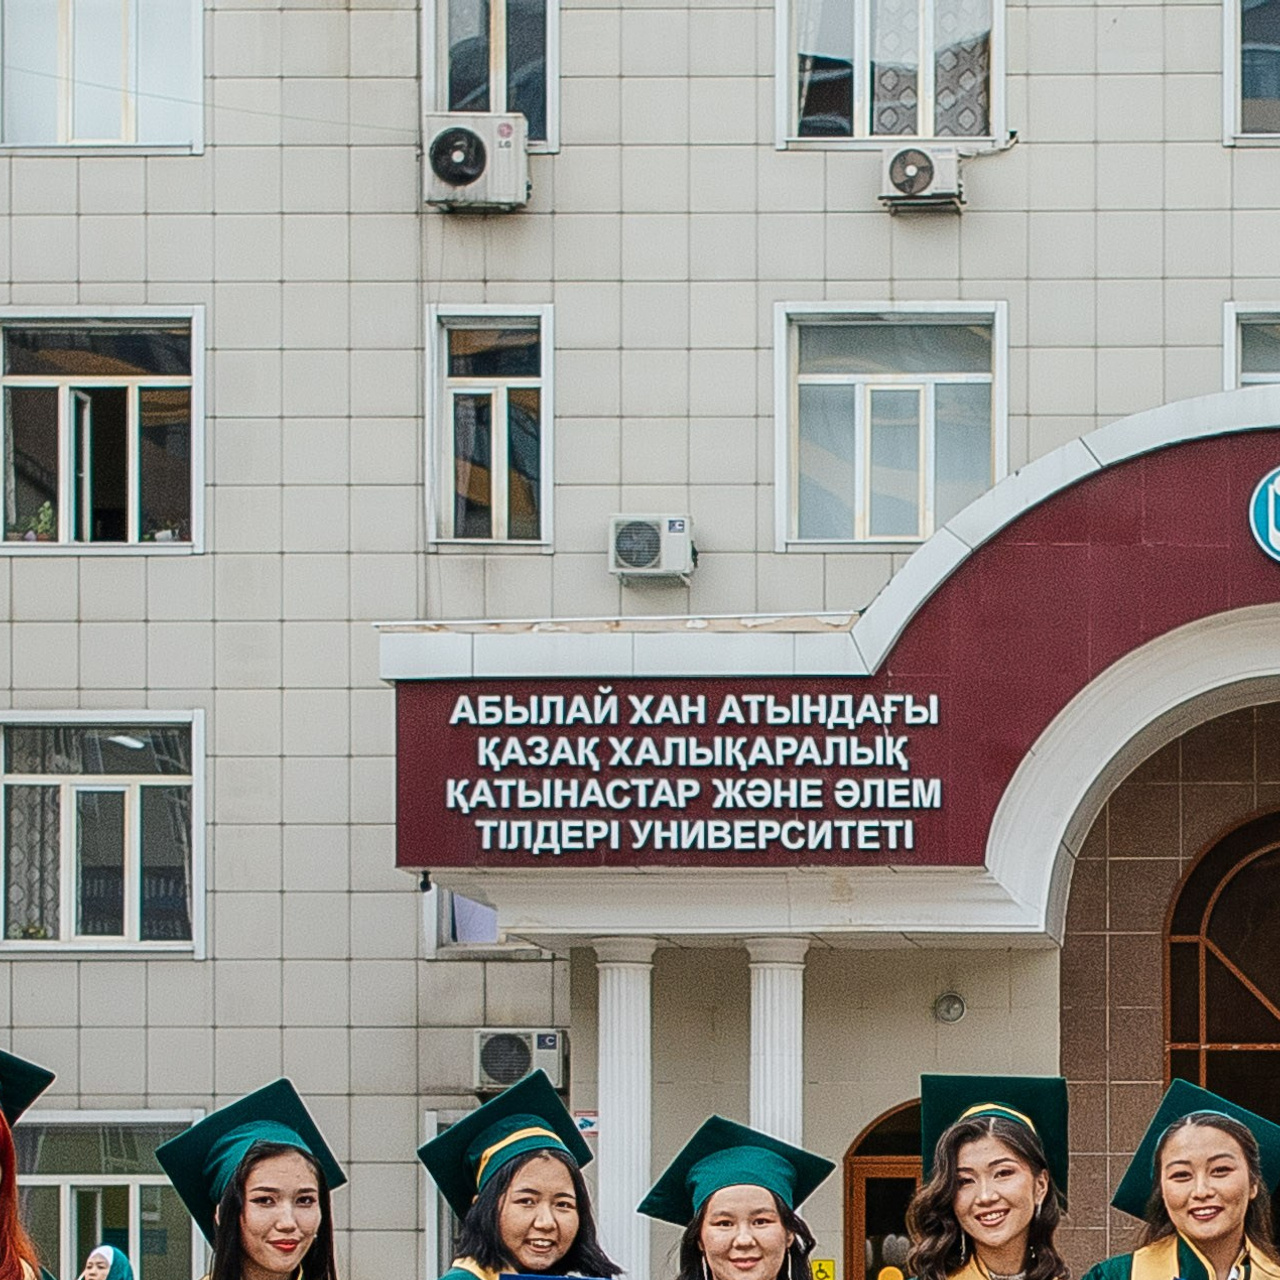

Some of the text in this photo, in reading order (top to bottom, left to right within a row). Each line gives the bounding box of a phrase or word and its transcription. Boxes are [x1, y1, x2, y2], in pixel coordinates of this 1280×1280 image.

[450, 686, 938, 730] АБЫЛАЙ ХАН АТЫНДАҒЫ
[479, 736, 908, 772] ҚАЗАҚ ХАЛЫҚАРАЛЫҚ
[447, 779, 941, 813] ҚАТЫНАСТАР ЖӘНЕ ӘЛЕМ
[475, 820, 914, 855] ТІЛДЕРІ УНИВЕРСИТЕТІ
